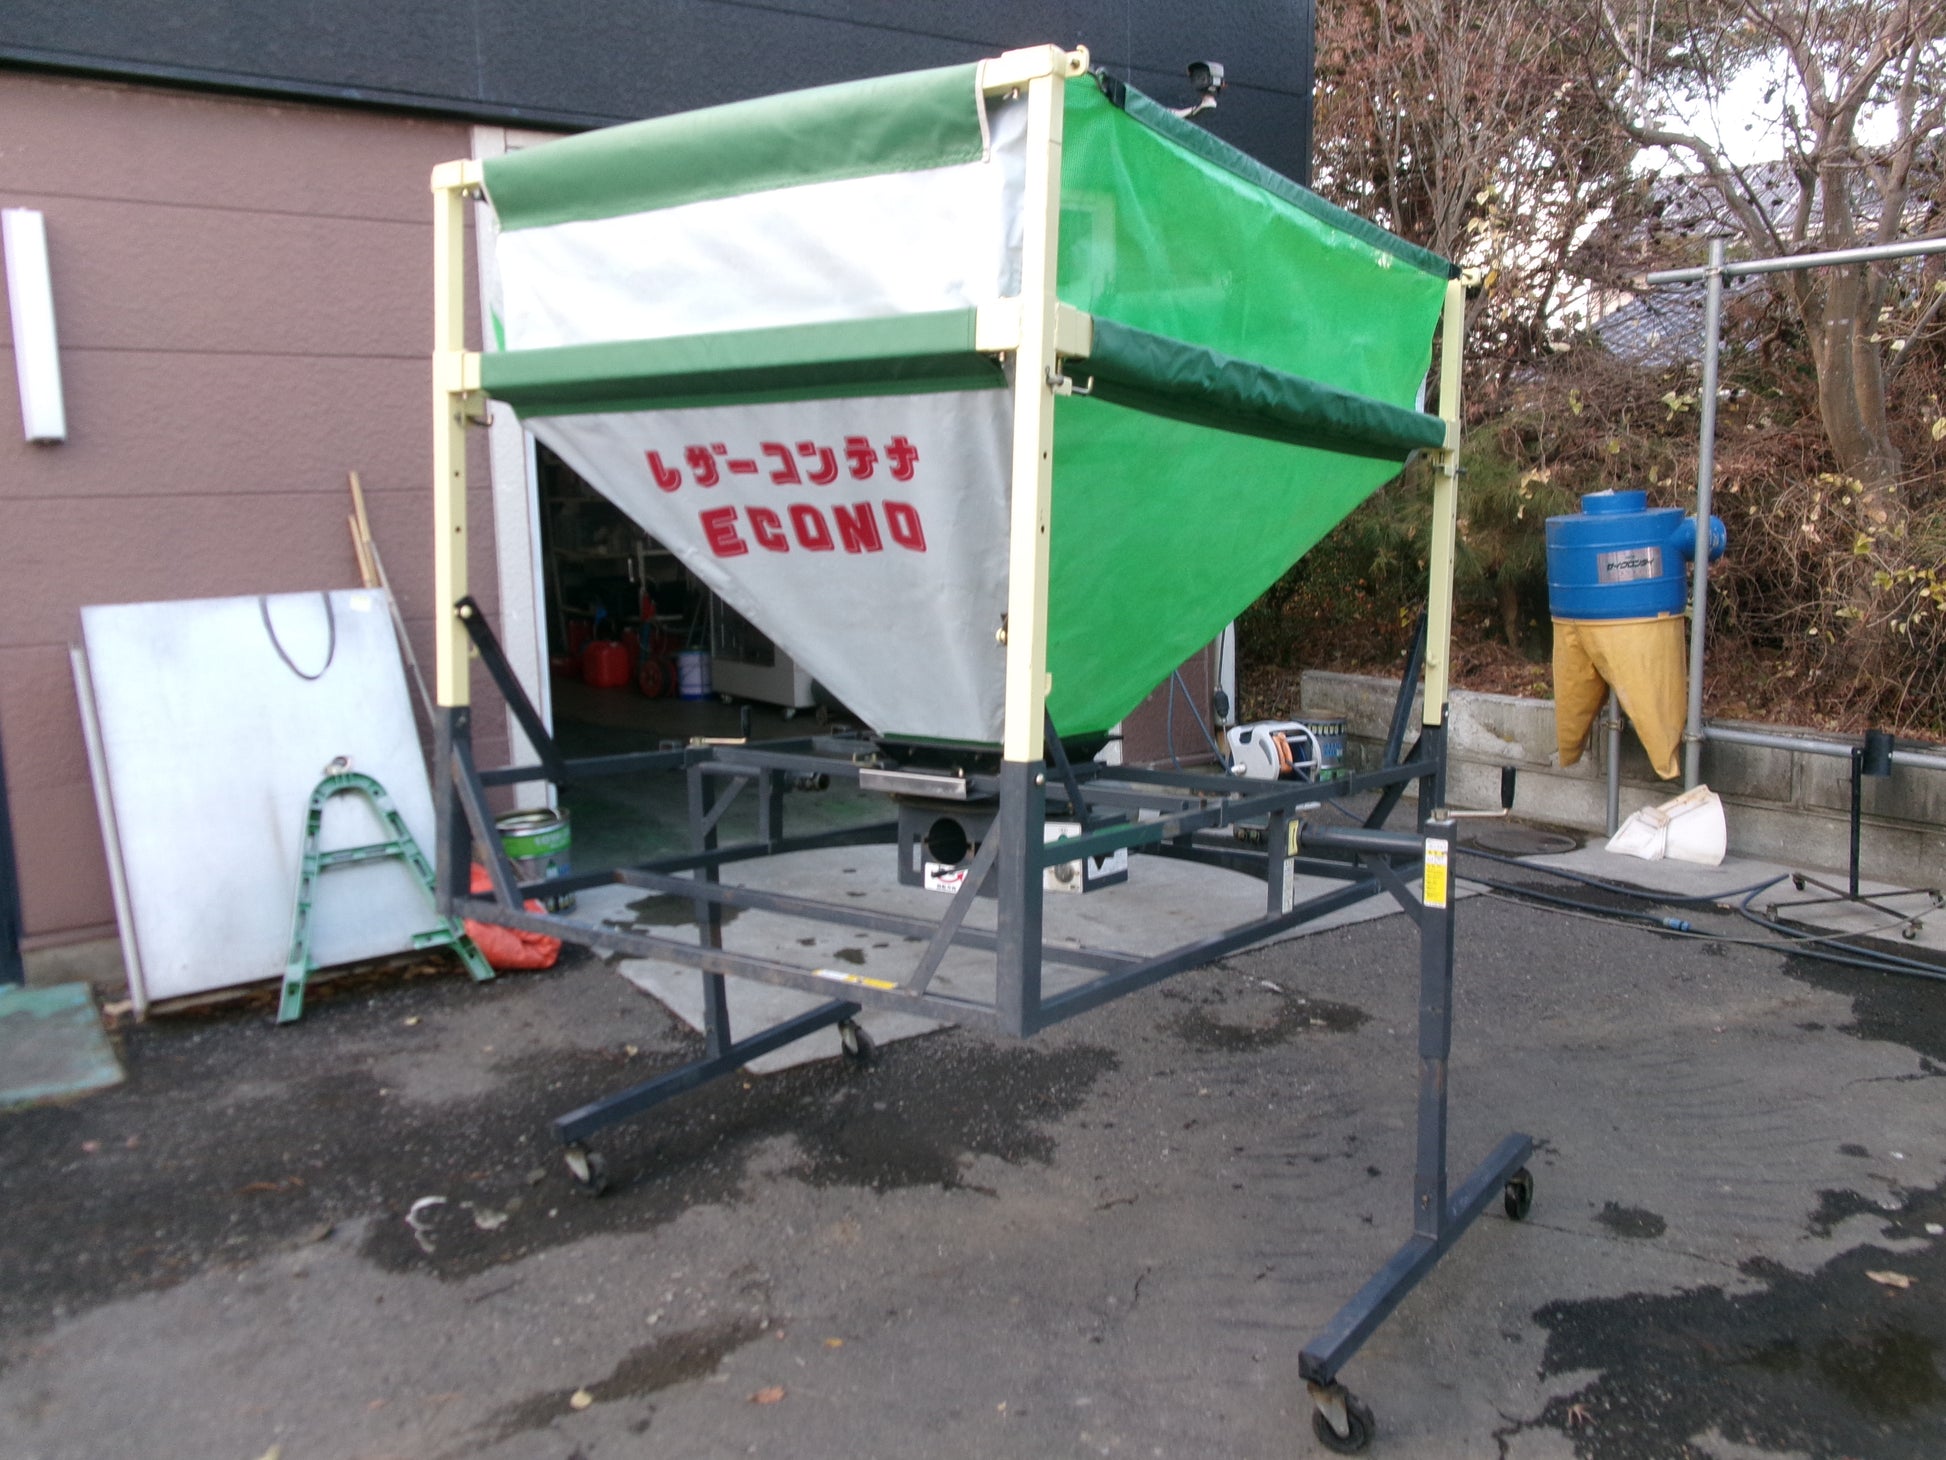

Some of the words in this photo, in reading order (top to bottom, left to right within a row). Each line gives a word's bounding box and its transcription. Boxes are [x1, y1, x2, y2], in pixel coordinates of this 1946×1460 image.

[645, 435, 919, 492] レザーコンテナ
[698, 499, 927, 558] ECONO
